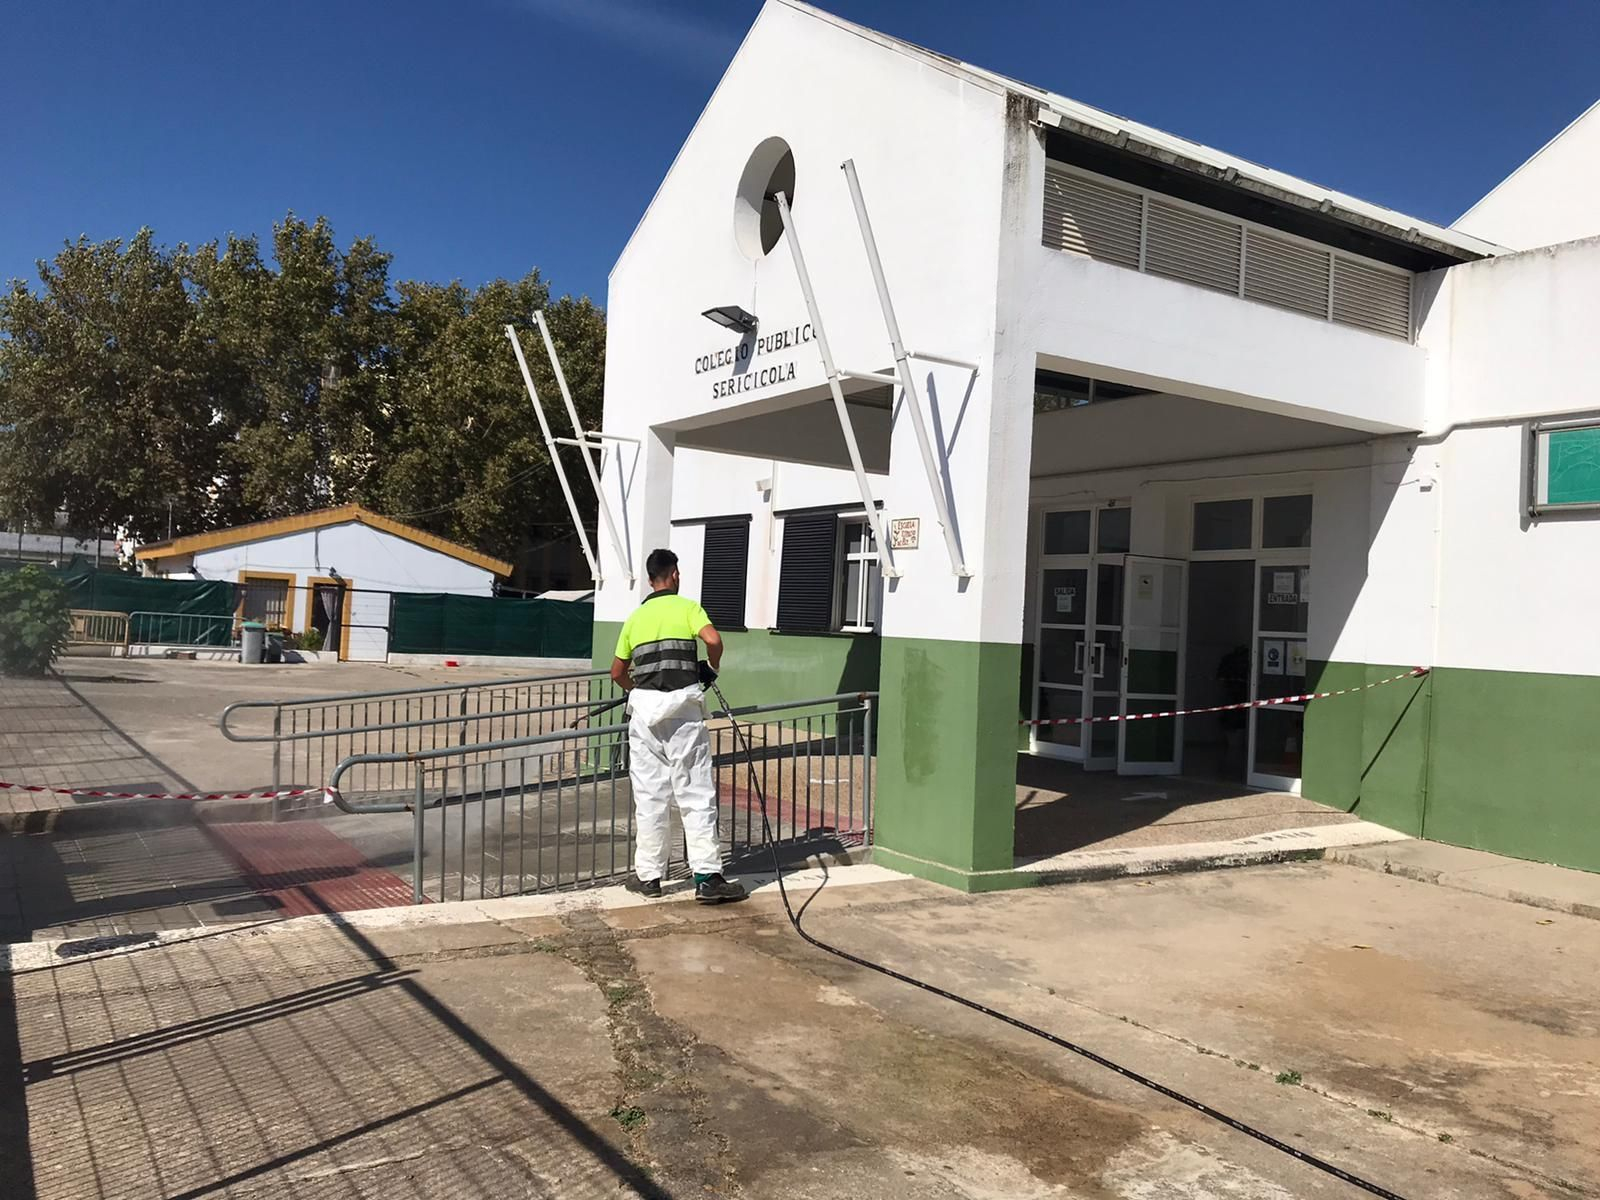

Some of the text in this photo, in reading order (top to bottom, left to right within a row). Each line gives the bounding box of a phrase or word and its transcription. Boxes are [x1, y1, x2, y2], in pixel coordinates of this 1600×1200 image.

[695, 343, 749, 374] COLEGIO
[713, 361, 796, 400] SERICICOLA
[1268, 593, 1297, 604] ENTRADA
